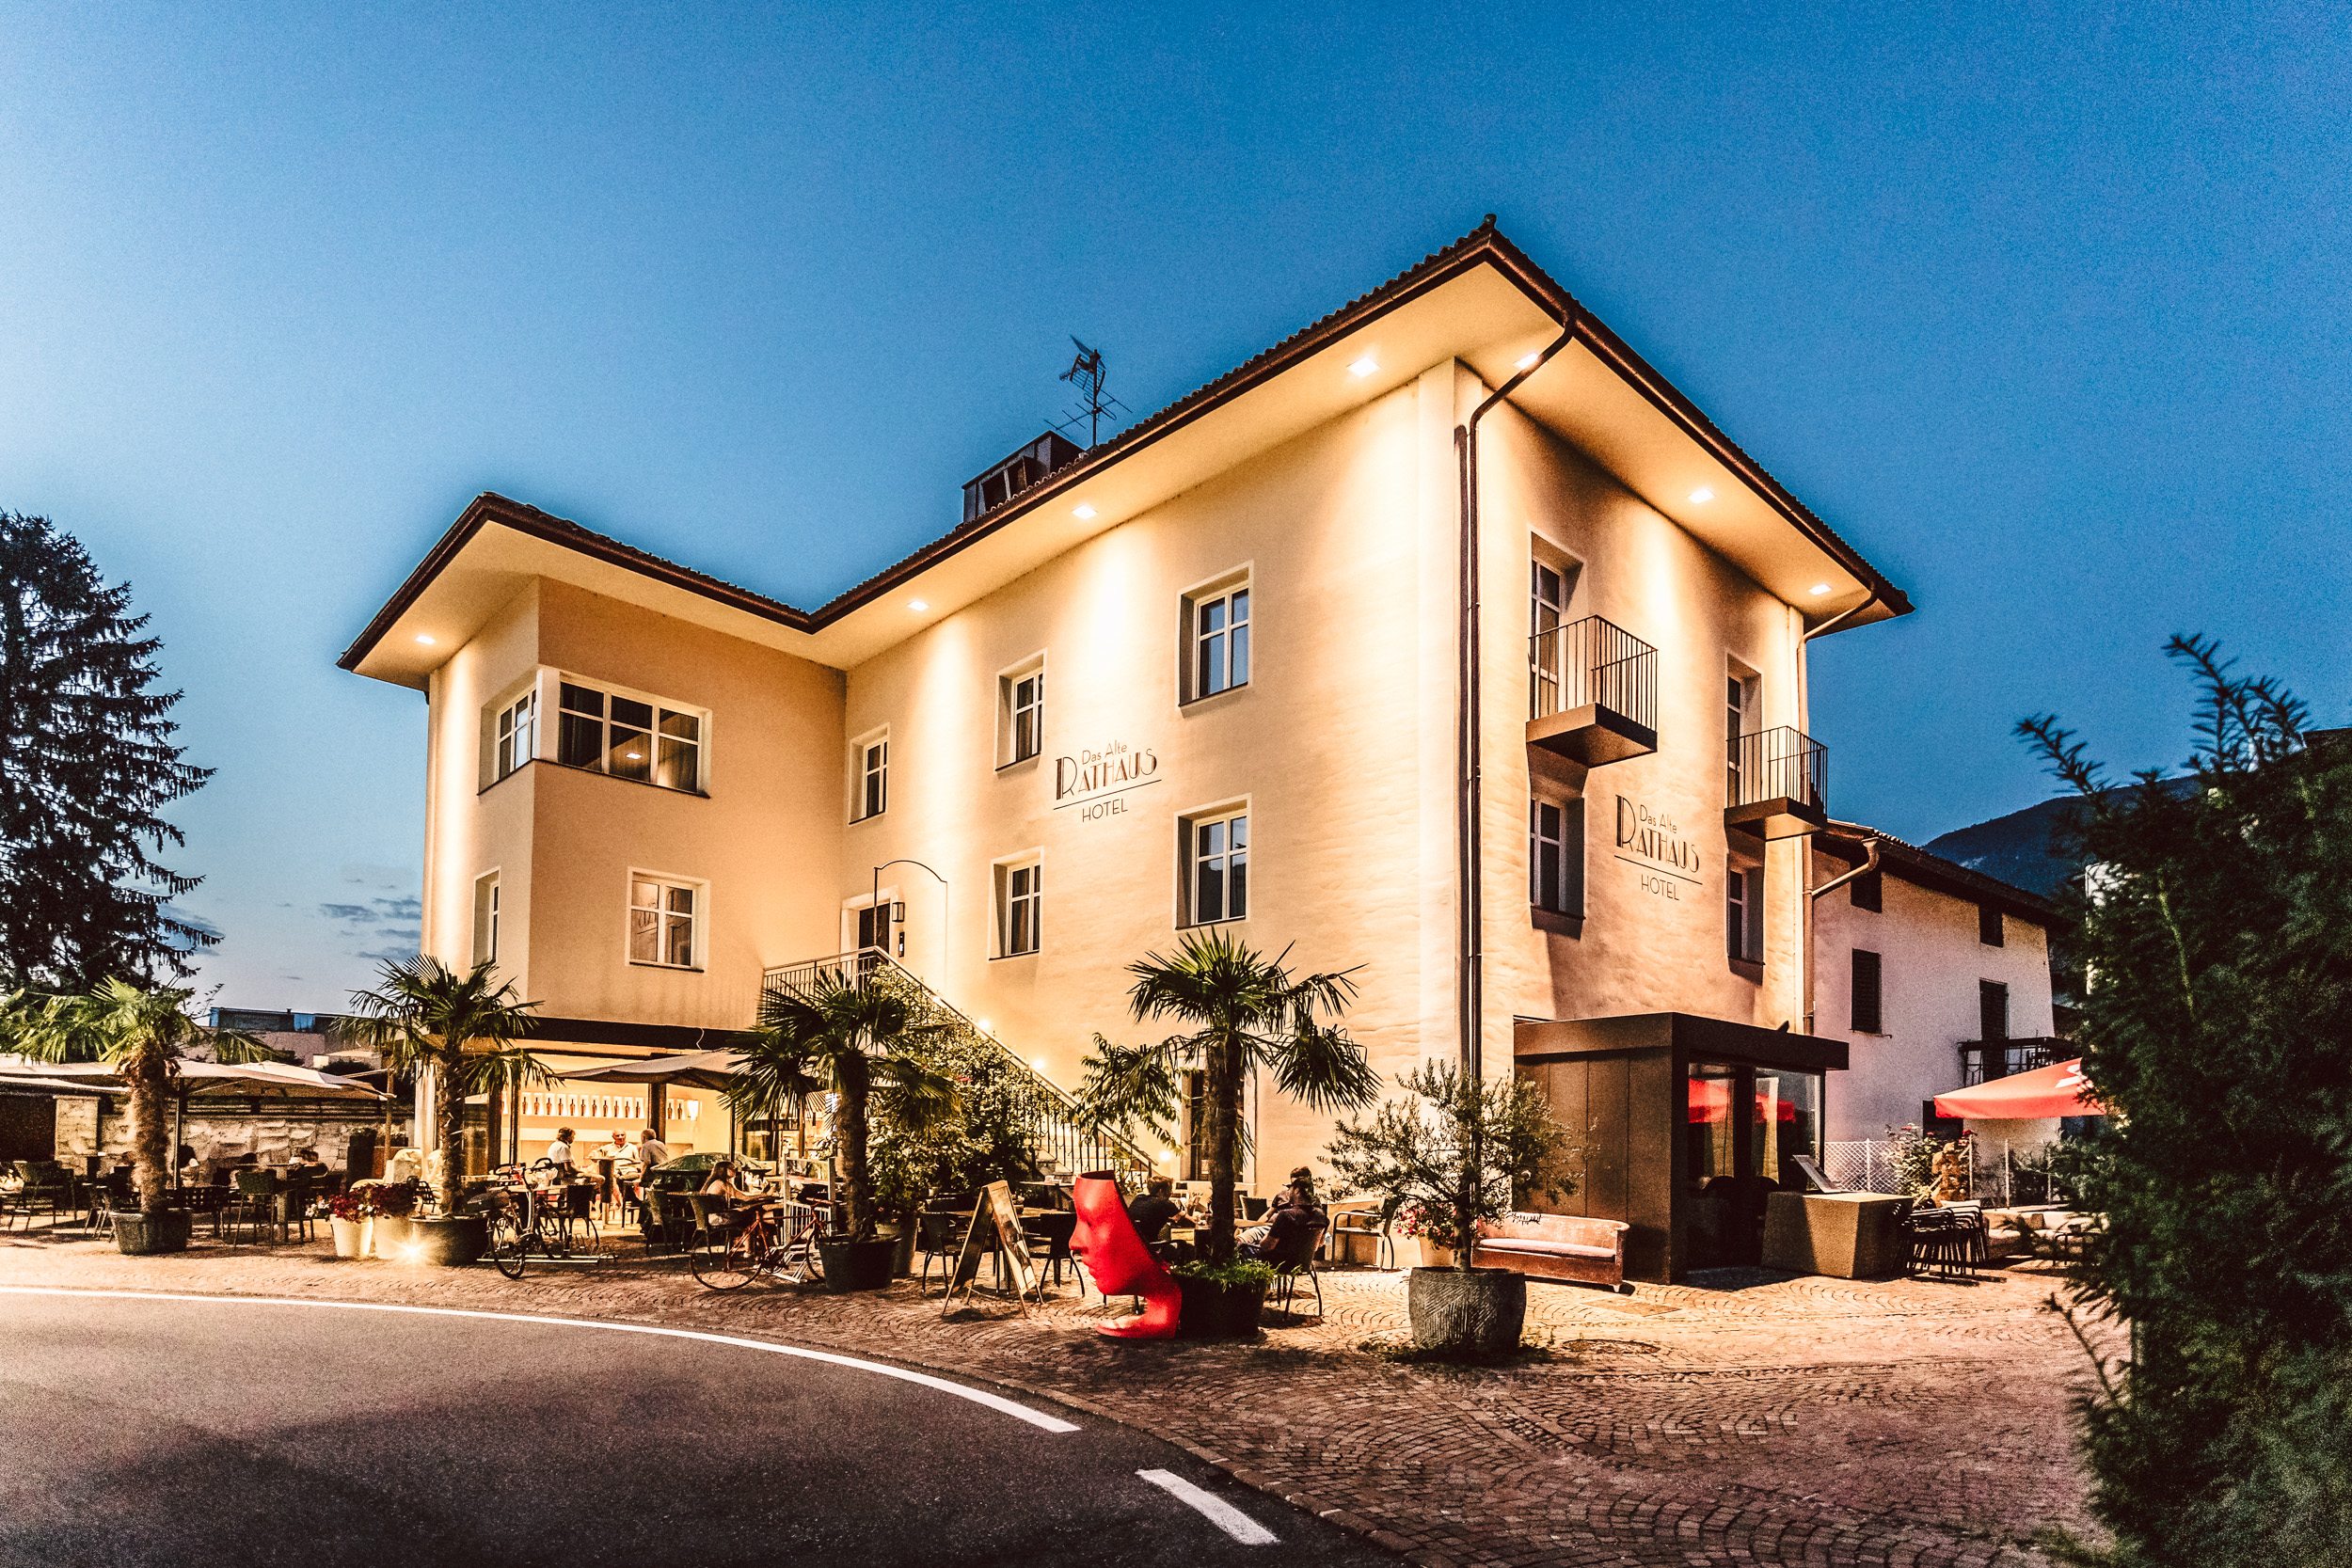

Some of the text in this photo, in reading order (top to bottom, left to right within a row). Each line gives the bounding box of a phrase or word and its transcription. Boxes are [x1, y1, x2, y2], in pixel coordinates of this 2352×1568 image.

[1082, 739, 1128, 765] Das Alte
[1055, 748, 1158, 800] RATHAUS
[1082, 798, 1128, 823] HOTEL
[1640, 804, 1677, 834] Das Alte
[1615, 794, 1699, 873] RATHAUS
[1641, 873, 1679, 901] HOTEL
